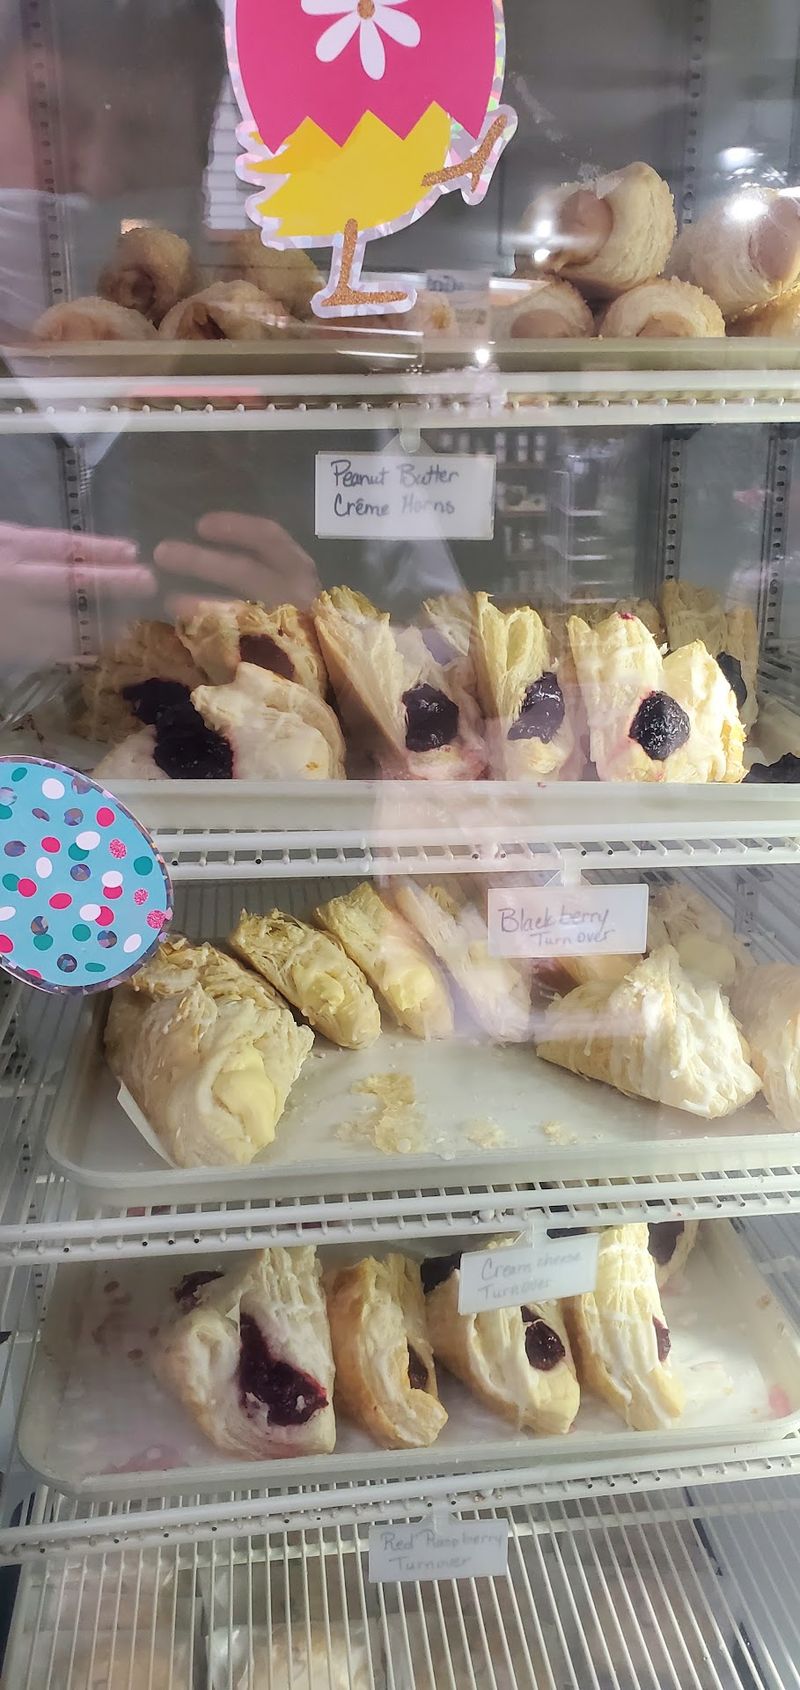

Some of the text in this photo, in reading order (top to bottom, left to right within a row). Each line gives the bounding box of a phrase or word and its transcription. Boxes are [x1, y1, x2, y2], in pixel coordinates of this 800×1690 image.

[331, 459, 460, 488] Peanut Butter
[401, 492, 456, 515] Horns
[481, 1257, 532, 1281] Cream
[380, 1531, 414, 1551] Red
